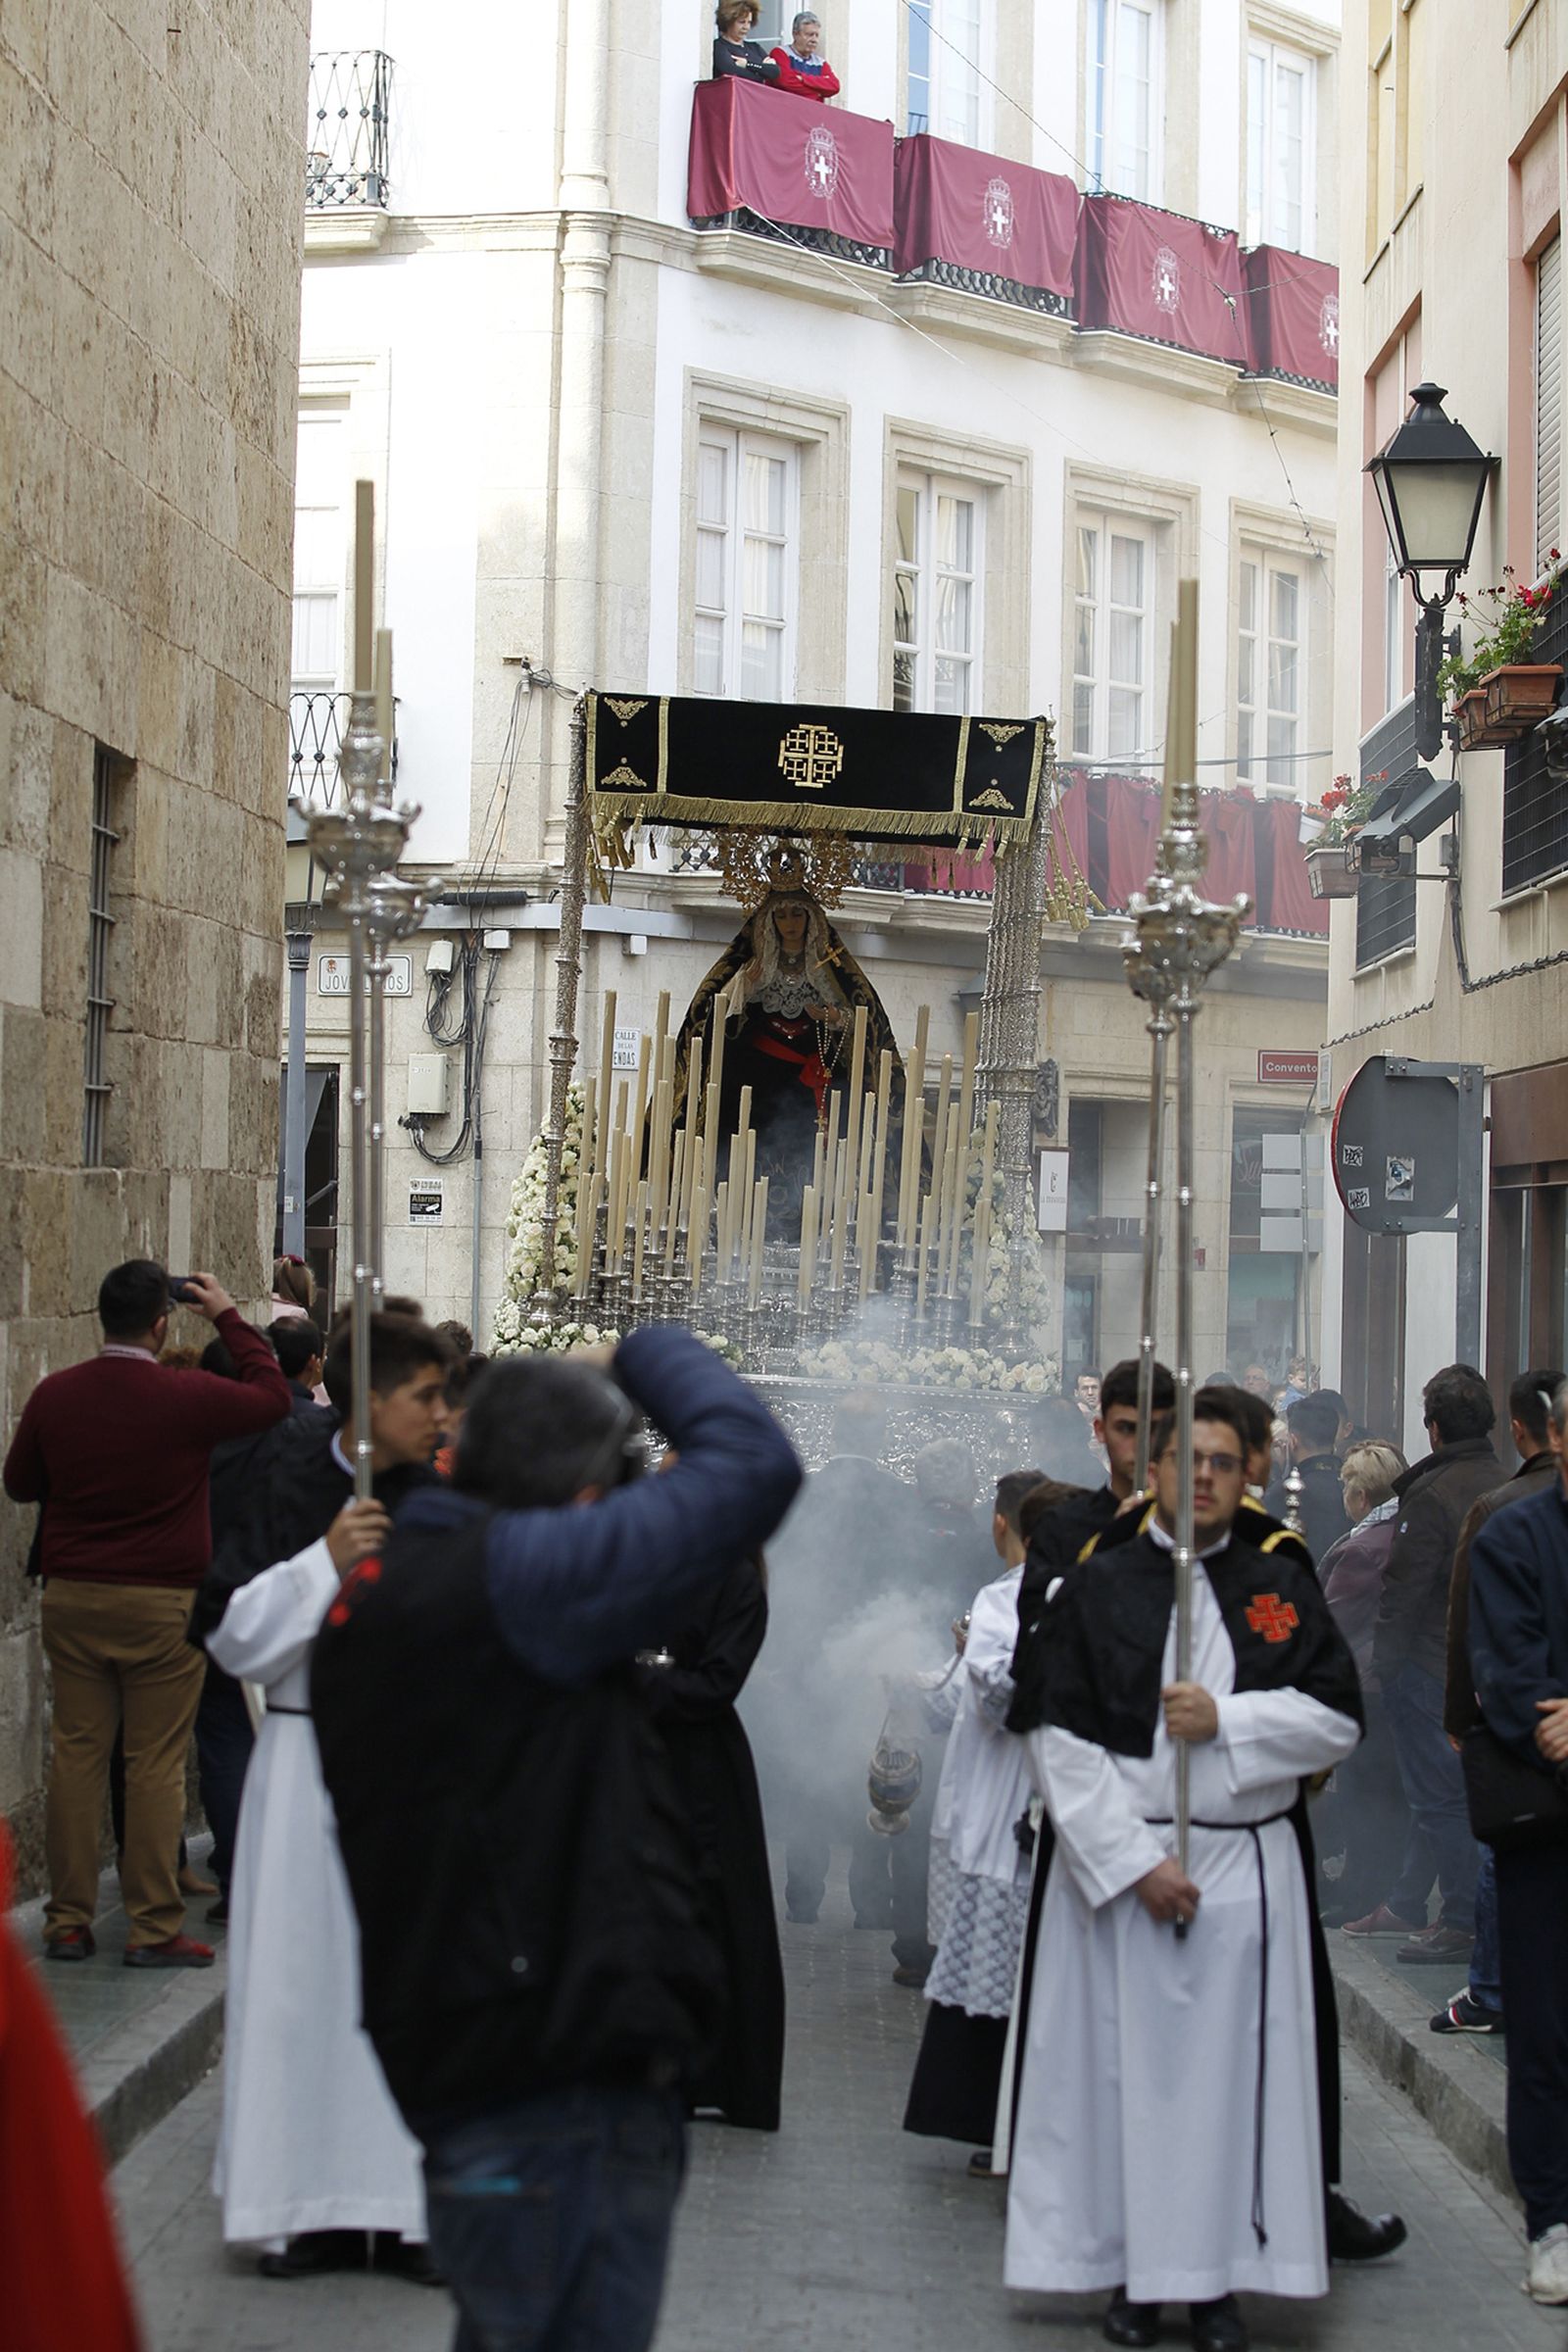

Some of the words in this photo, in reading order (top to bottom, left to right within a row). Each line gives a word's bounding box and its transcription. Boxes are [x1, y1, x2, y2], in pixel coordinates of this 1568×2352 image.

[325, 975, 403, 991] JOVLOS
[614, 1031, 637, 1041] CALLE
[613, 1051, 636, 1066] ENDAS
[1265, 1061, 1317, 1073] Convento
[411, 1195, 441, 1203] Alarma
